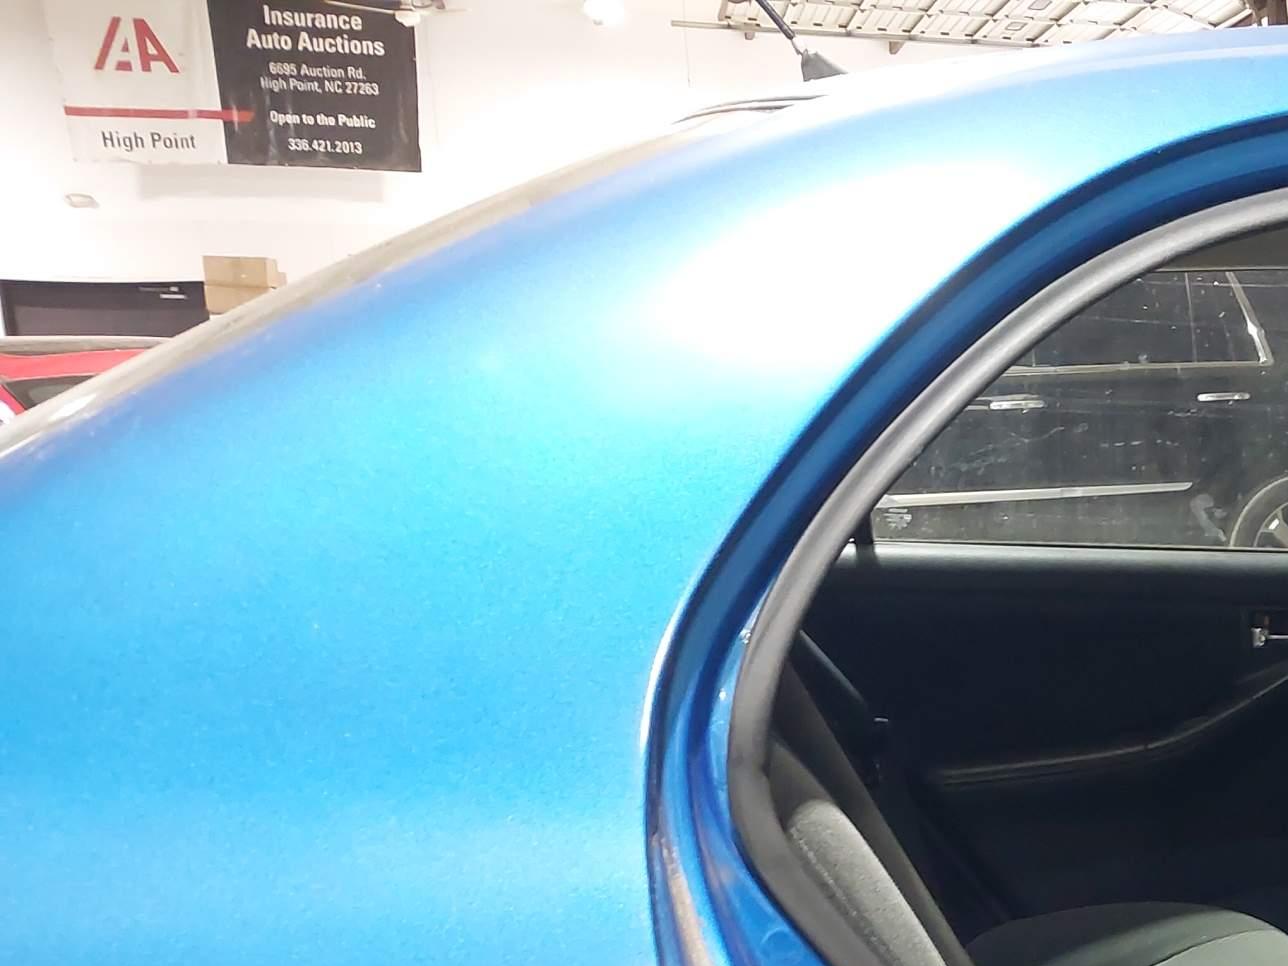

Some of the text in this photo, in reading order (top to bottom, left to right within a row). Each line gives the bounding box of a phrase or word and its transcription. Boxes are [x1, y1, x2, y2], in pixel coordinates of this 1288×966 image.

[263, 5, 363, 31] Insurance
[246, 28, 386, 56] Auto Auctions
[269, 62, 367, 80] 6695 Auction Rd.
[260, 76, 379, 95] High Point, NC 27263
[270, 110, 376, 128] Open to the Public
[101, 130, 196, 152] High Point
[288, 138, 363, 154] 336.421.2013
